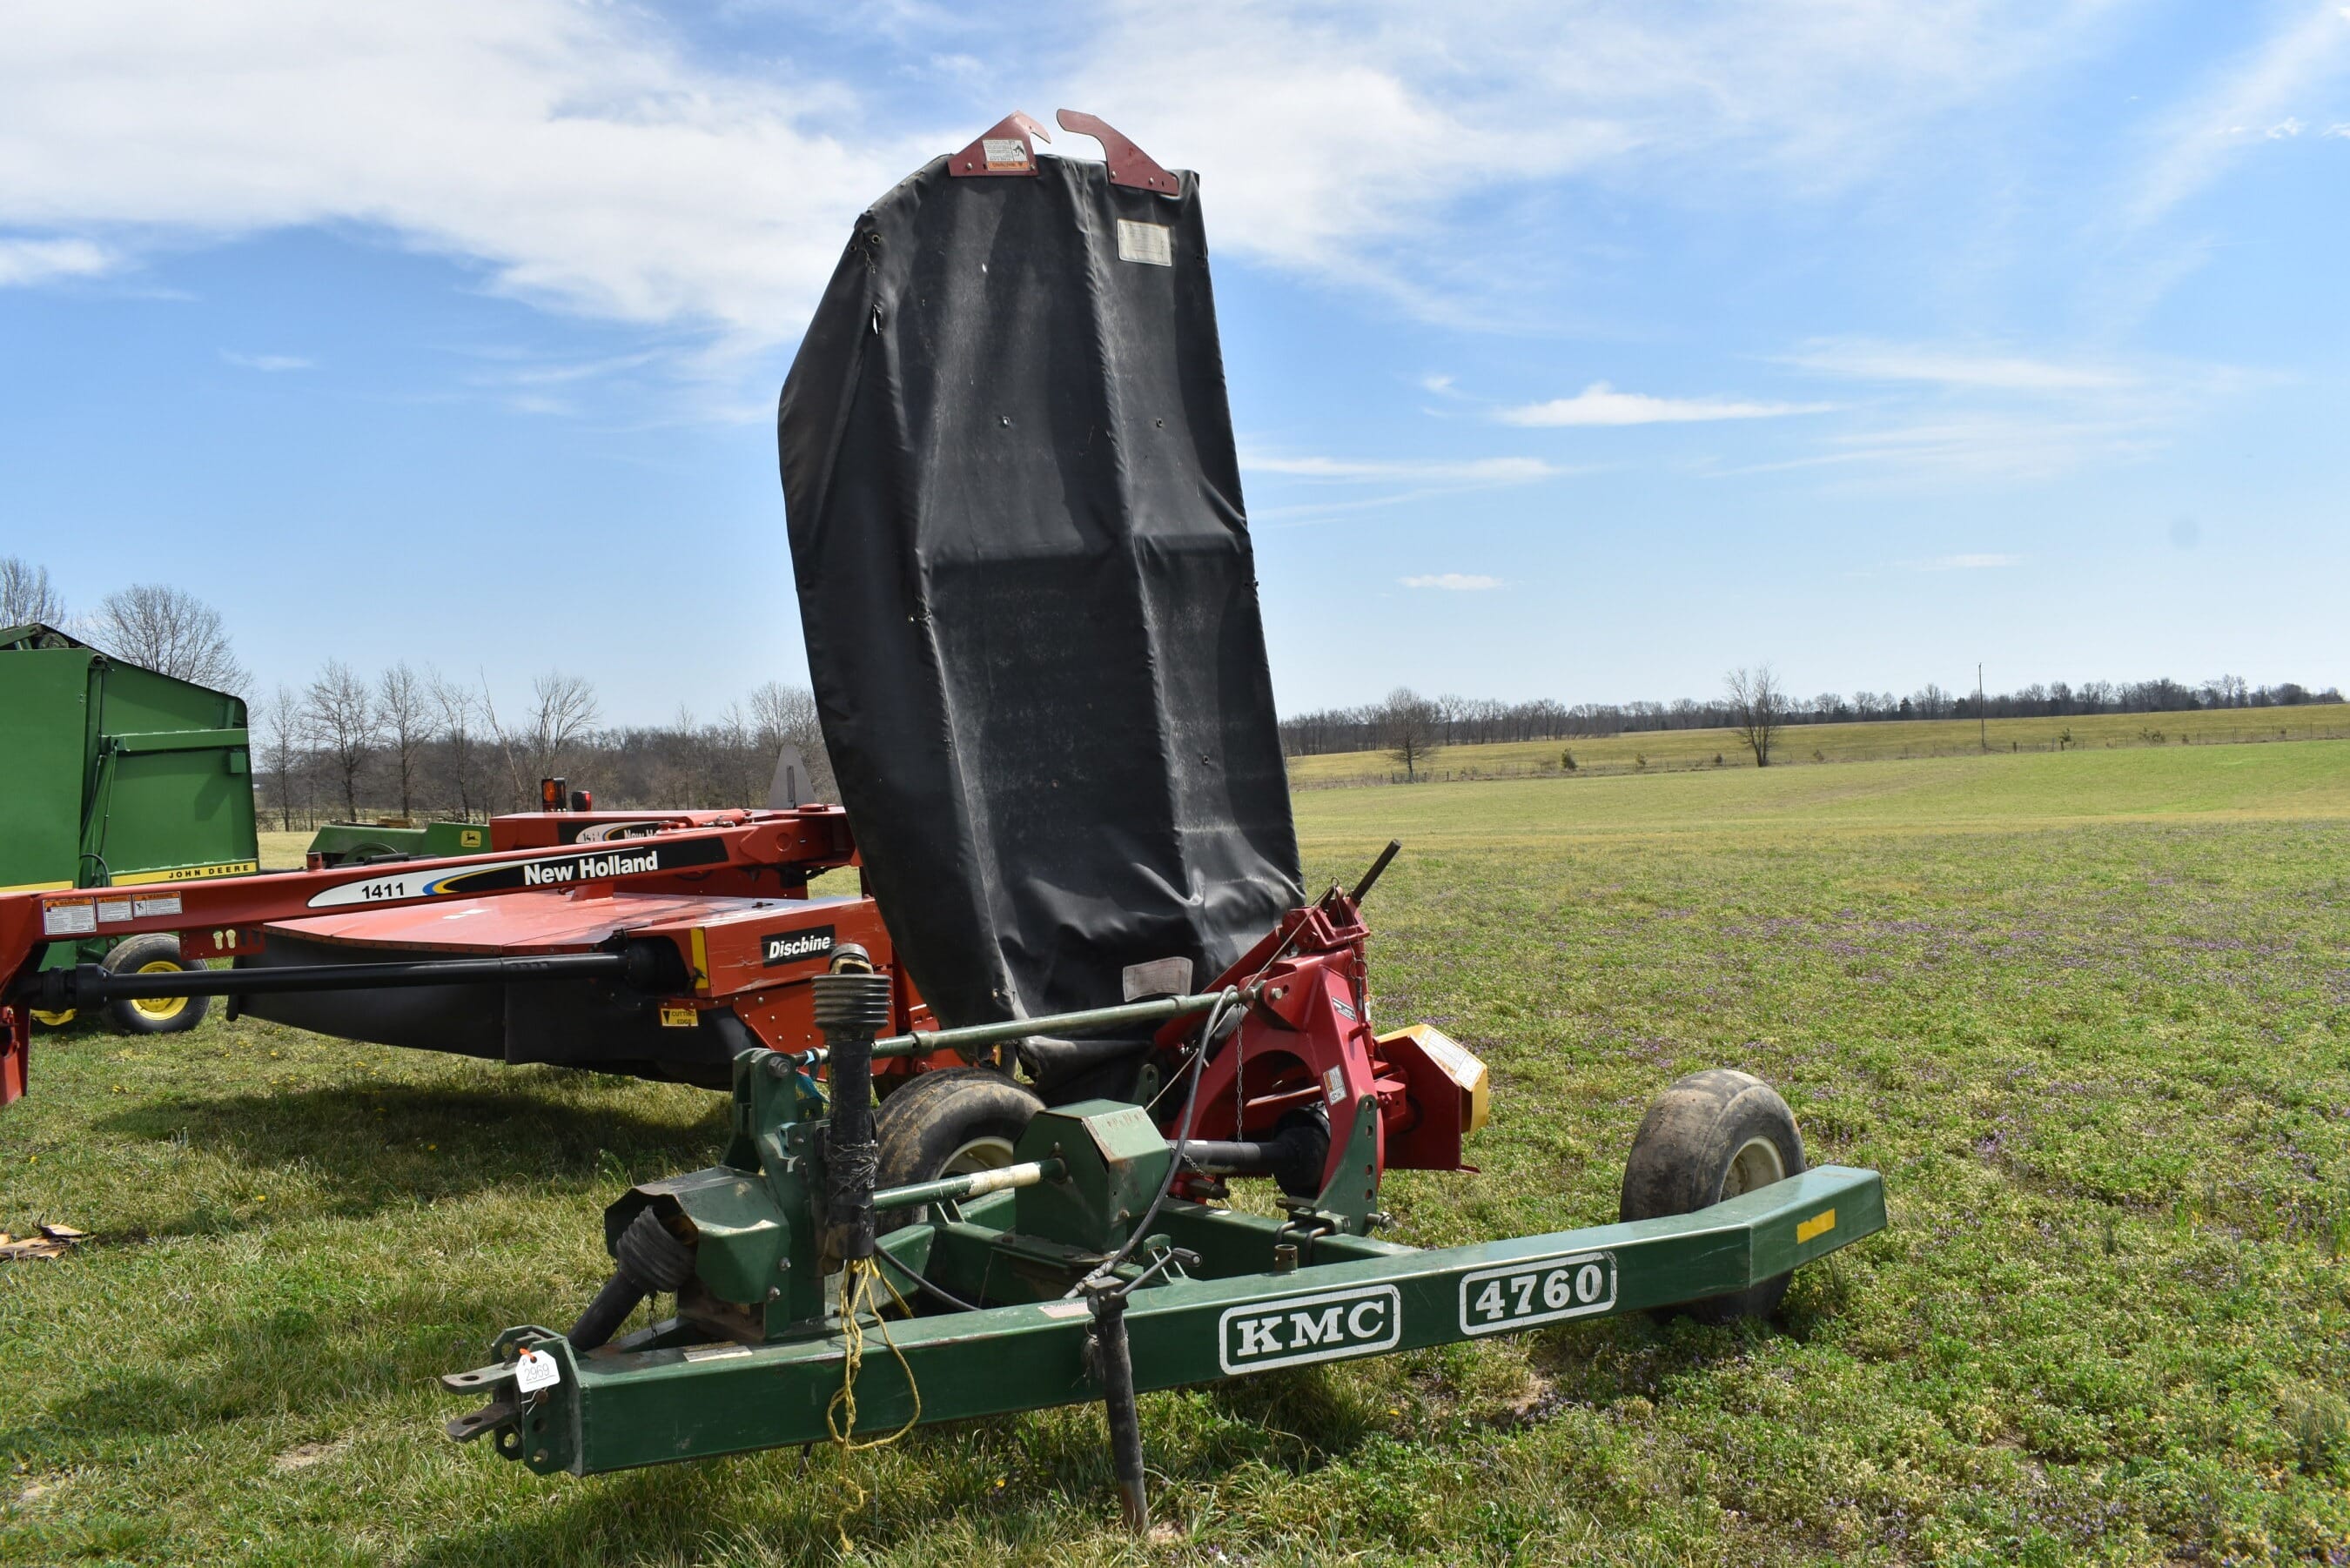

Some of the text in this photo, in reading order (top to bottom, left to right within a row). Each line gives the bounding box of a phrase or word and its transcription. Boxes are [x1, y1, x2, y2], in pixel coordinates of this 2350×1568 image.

[168, 864, 249, 879] JOHN DEERE
[523, 851, 658, 886] New Holland
[361, 881, 405, 900] 1411
[769, 935, 830, 959] Discbine
[1475, 1264, 1602, 1320] 4760
[1237, 1300, 1385, 1357] KMC
[524, 1363, 550, 1382] 2969
